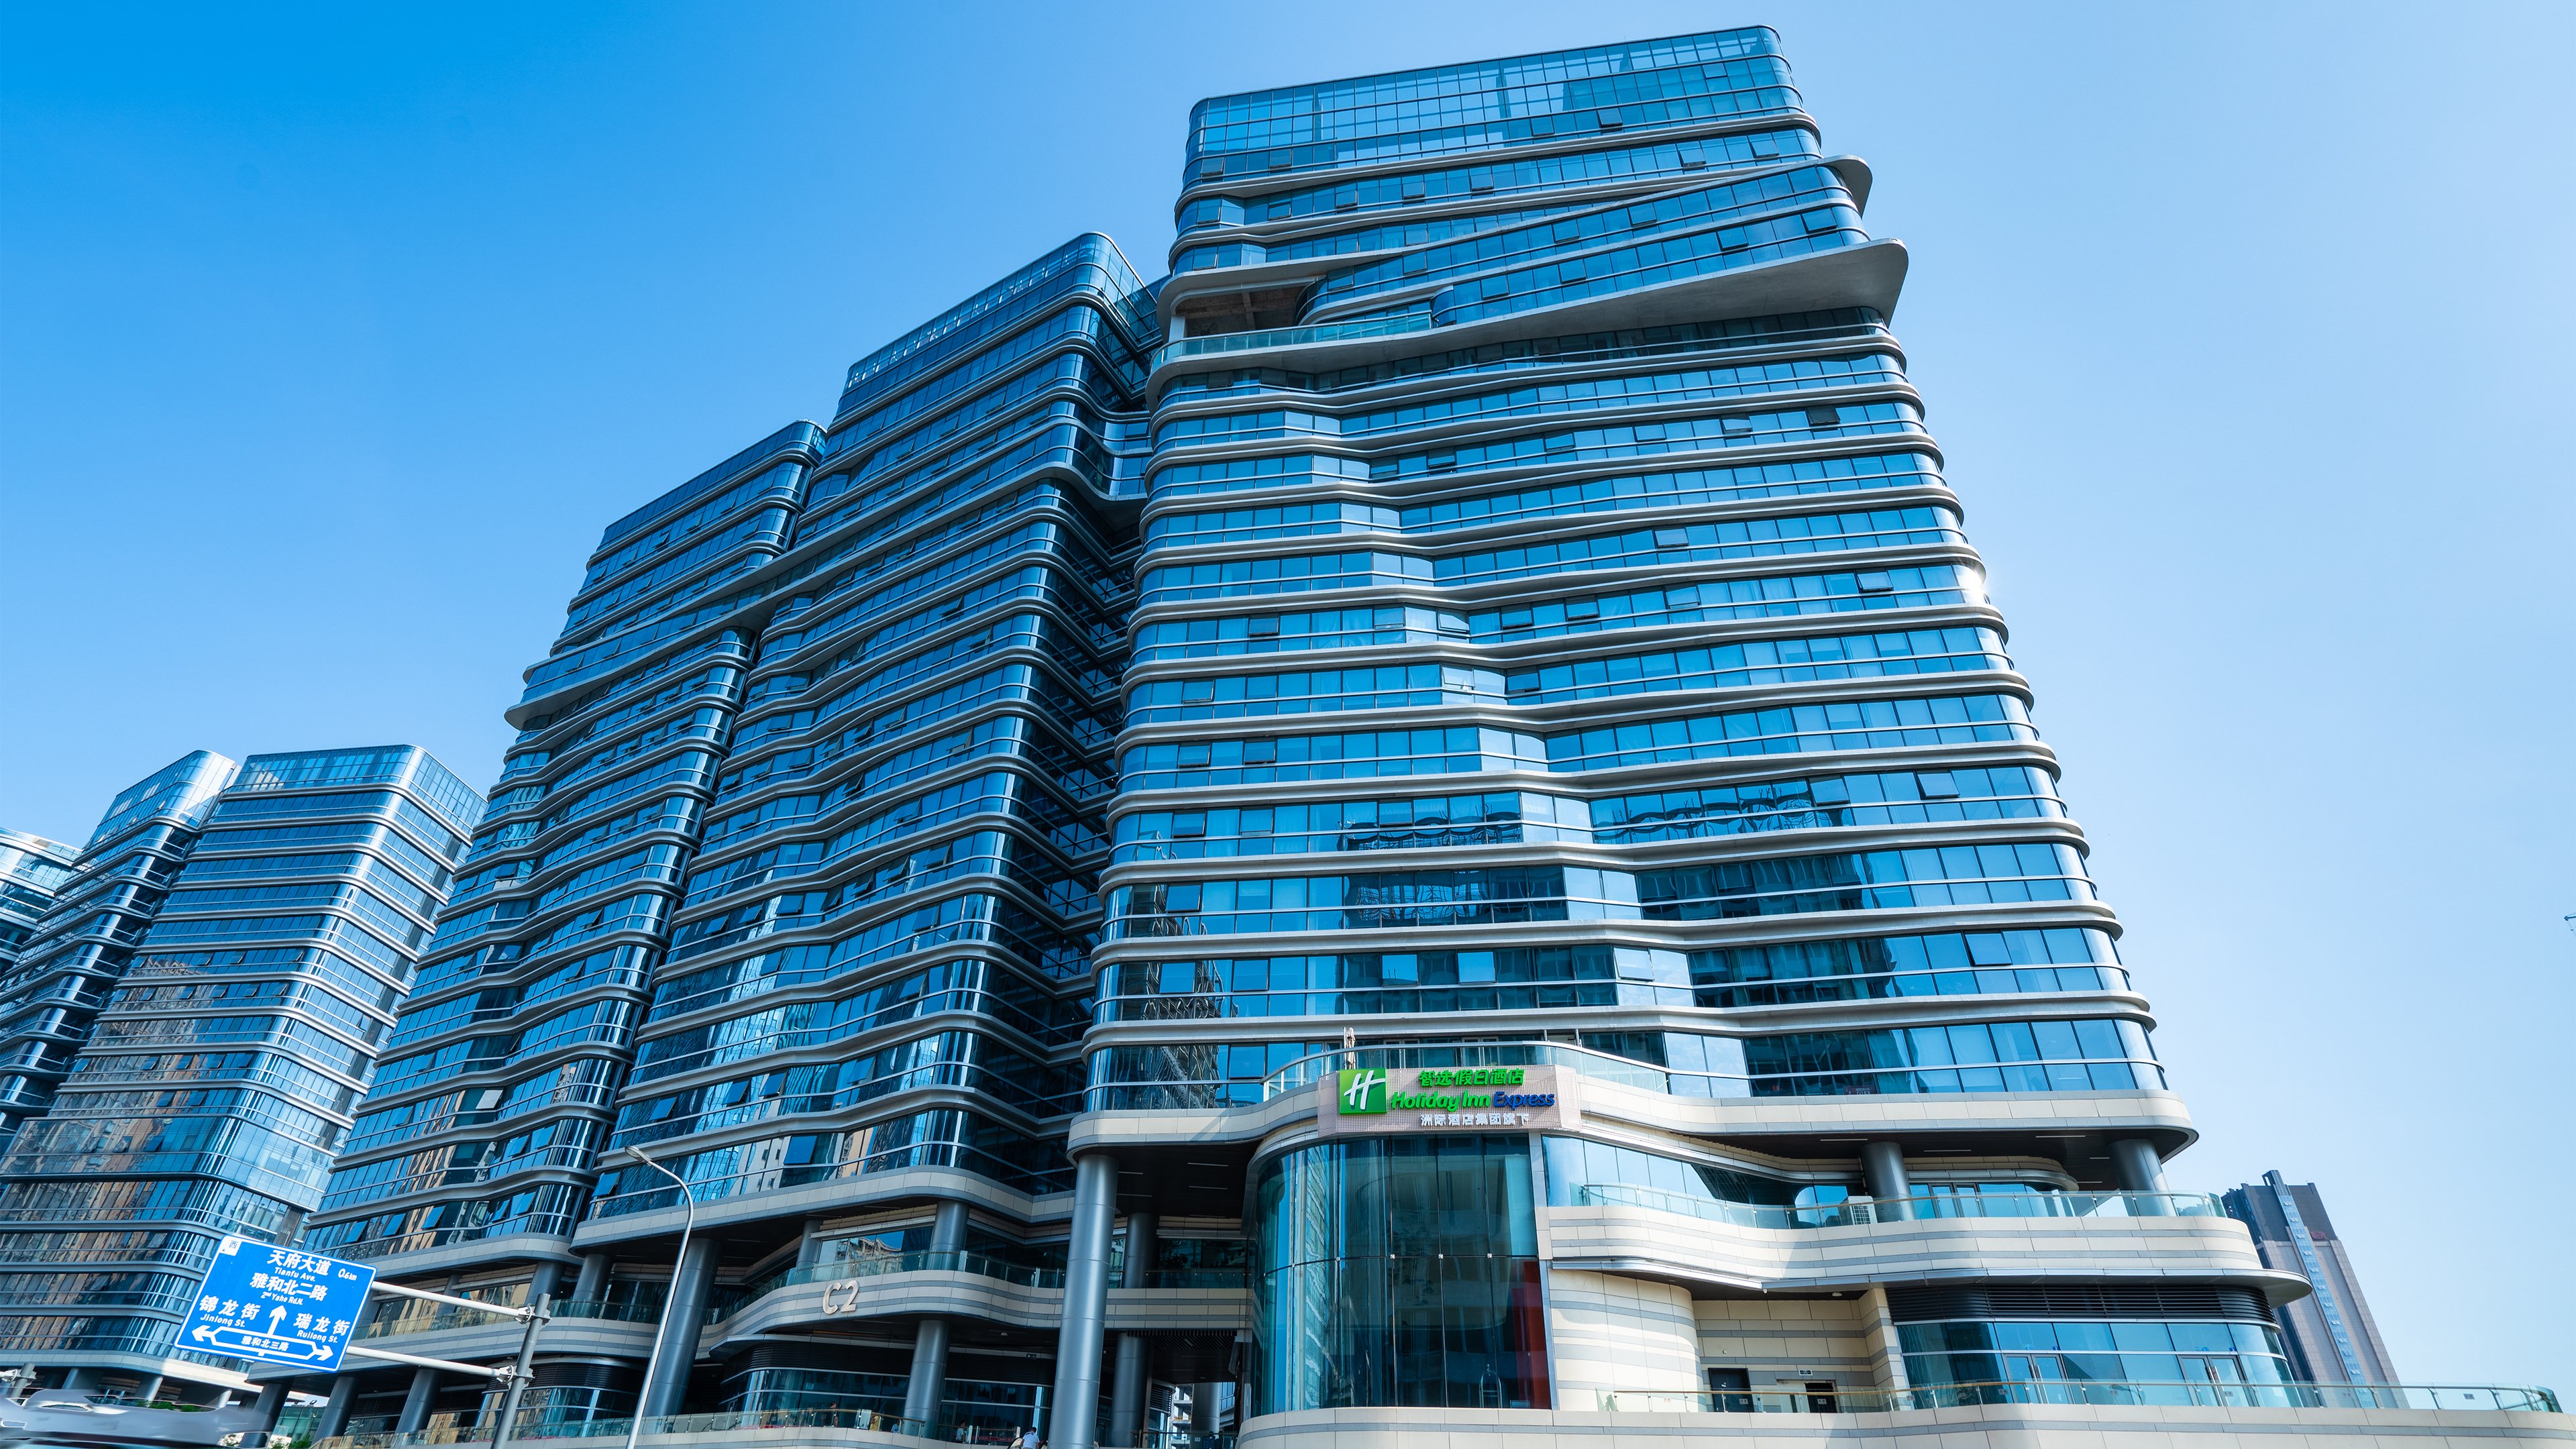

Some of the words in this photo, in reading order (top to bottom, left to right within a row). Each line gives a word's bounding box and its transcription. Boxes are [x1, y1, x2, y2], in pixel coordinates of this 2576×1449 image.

[1419, 1067, 1525, 1087] 智选假日酒店
[1391, 1091, 1460, 1112] Holiday
[1462, 1089, 1491, 1108] Inn
[1493, 1091, 1556, 1111] Express
[1420, 1112, 1529, 1127] 洲际酒店集团旗下
[266, 1249, 332, 1276] 天府大道
[274, 1267, 299, 1278] Tianfu
[249, 1272, 328, 1301] 雅和北二路
[199, 1294, 262, 1320] 锦龙街
[272, 1293, 288, 1303] Yahe
[822, 1279, 859, 1315] C2
[200, 1313, 233, 1327] Jinlong
[234, 1319, 246, 1328] St.
[292, 1313, 351, 1336] 瑞龙街
[241, 1335, 290, 1352] 雅和北三路
[297, 1330, 327, 1343] Ruilong
[328, 1335, 338, 1344] St.
